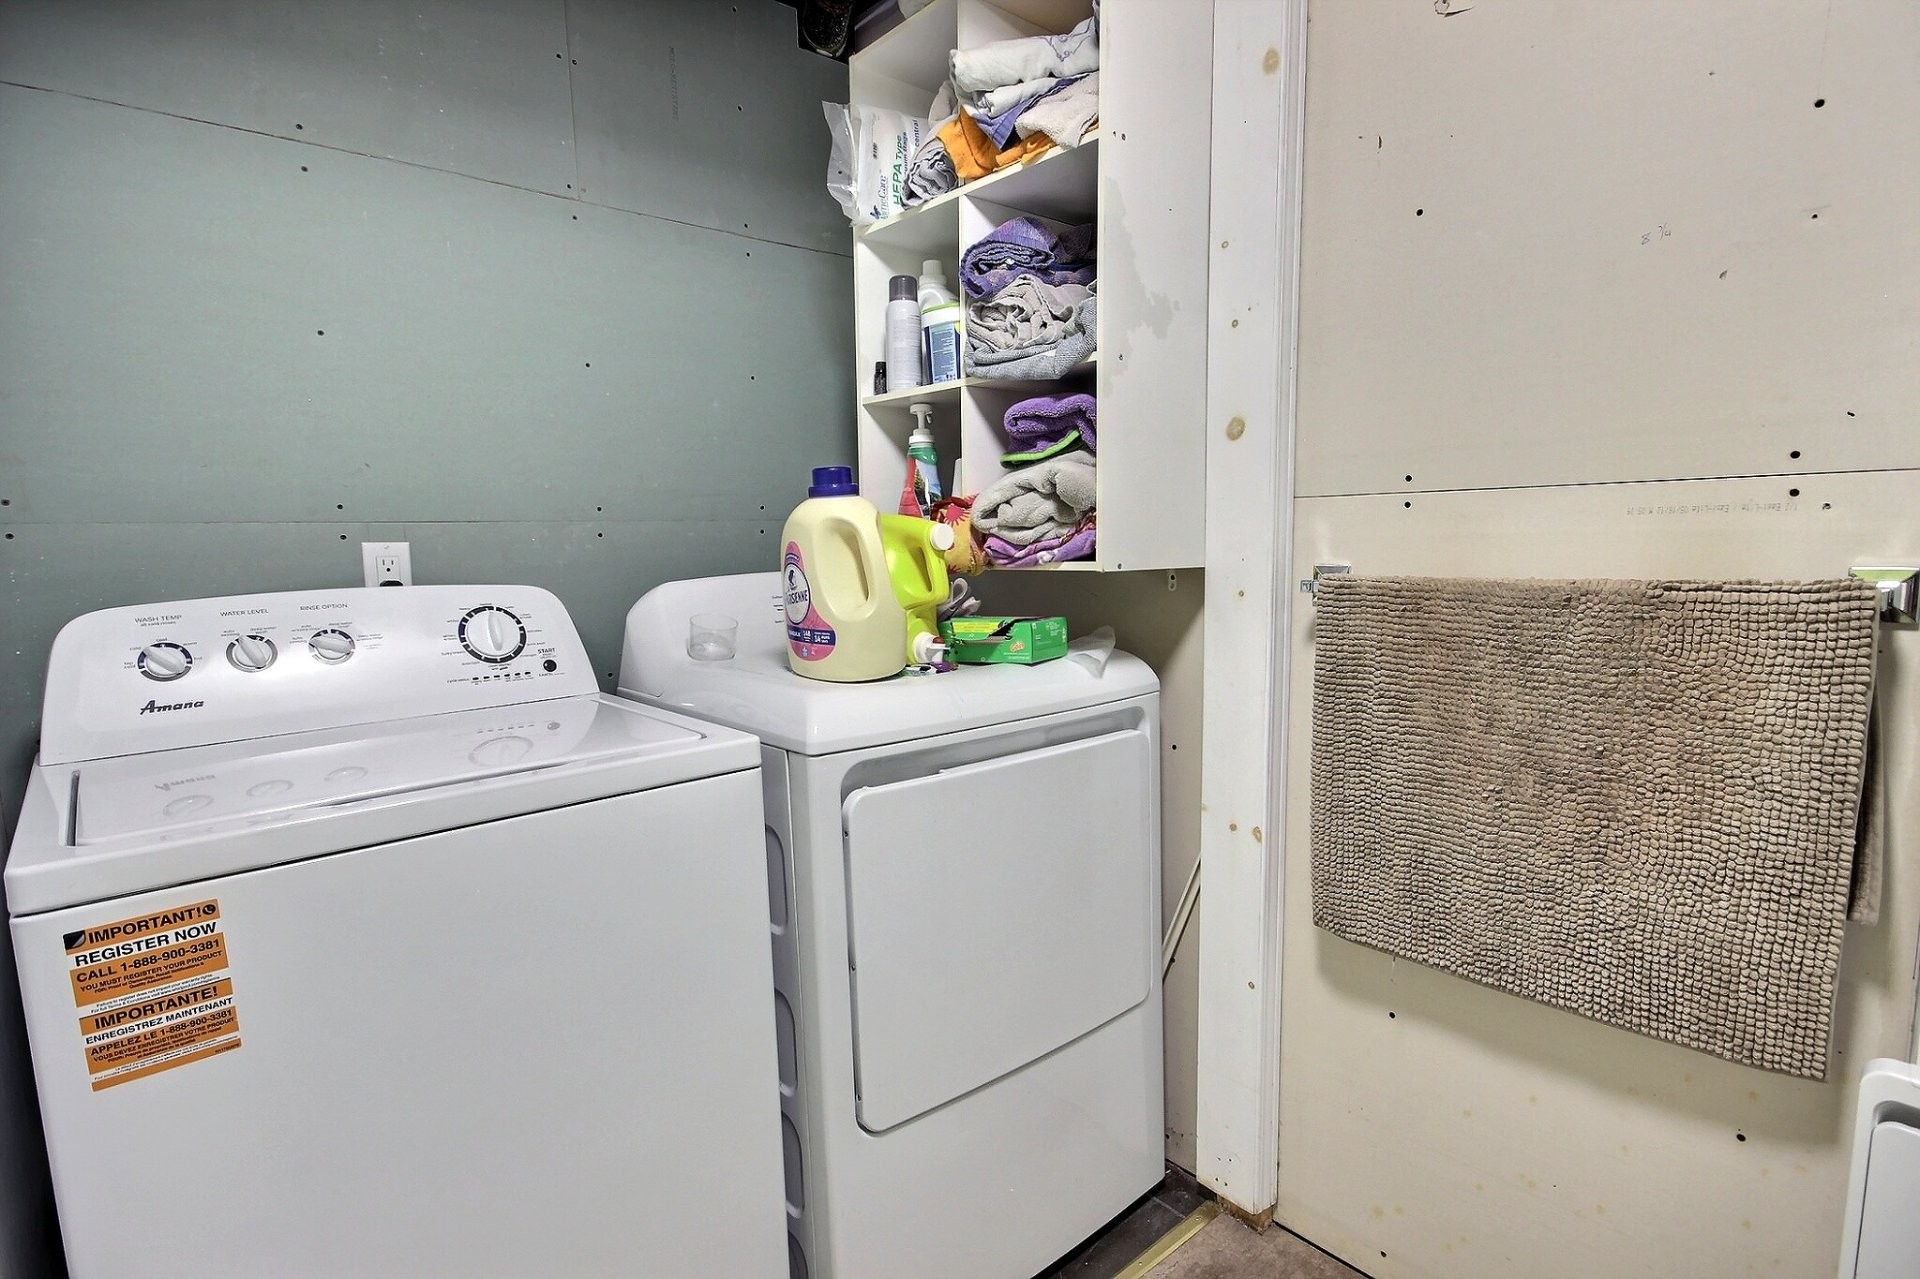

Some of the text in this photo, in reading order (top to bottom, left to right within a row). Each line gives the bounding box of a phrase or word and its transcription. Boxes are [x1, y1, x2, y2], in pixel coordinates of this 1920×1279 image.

[892, 135, 905, 206] HEPA Type
[161, 614, 182, 622] TEMP
[537, 647, 556, 655] START
[139, 699, 205, 716] Amana
[75, 922, 217, 967] REGISTER NOW
[88, 907, 201, 944] IMPORTANT!
[76, 939, 220, 983] CALL 1-888-900-3381
[80, 950, 222, 992] YOU MUST REGISTER YOUR PRODUCT
[86, 997, 233, 1045] ENREGISTREZ MAINTENANT
[95, 986, 218, 1029] IMPORTANTE!
[91, 1009, 232, 1056] APPELEZ LE 1-888-900-3381
[93, 1017, 234, 1062] VOUS DEVEZ ENREGISTRER VOTRE PRODUIT
